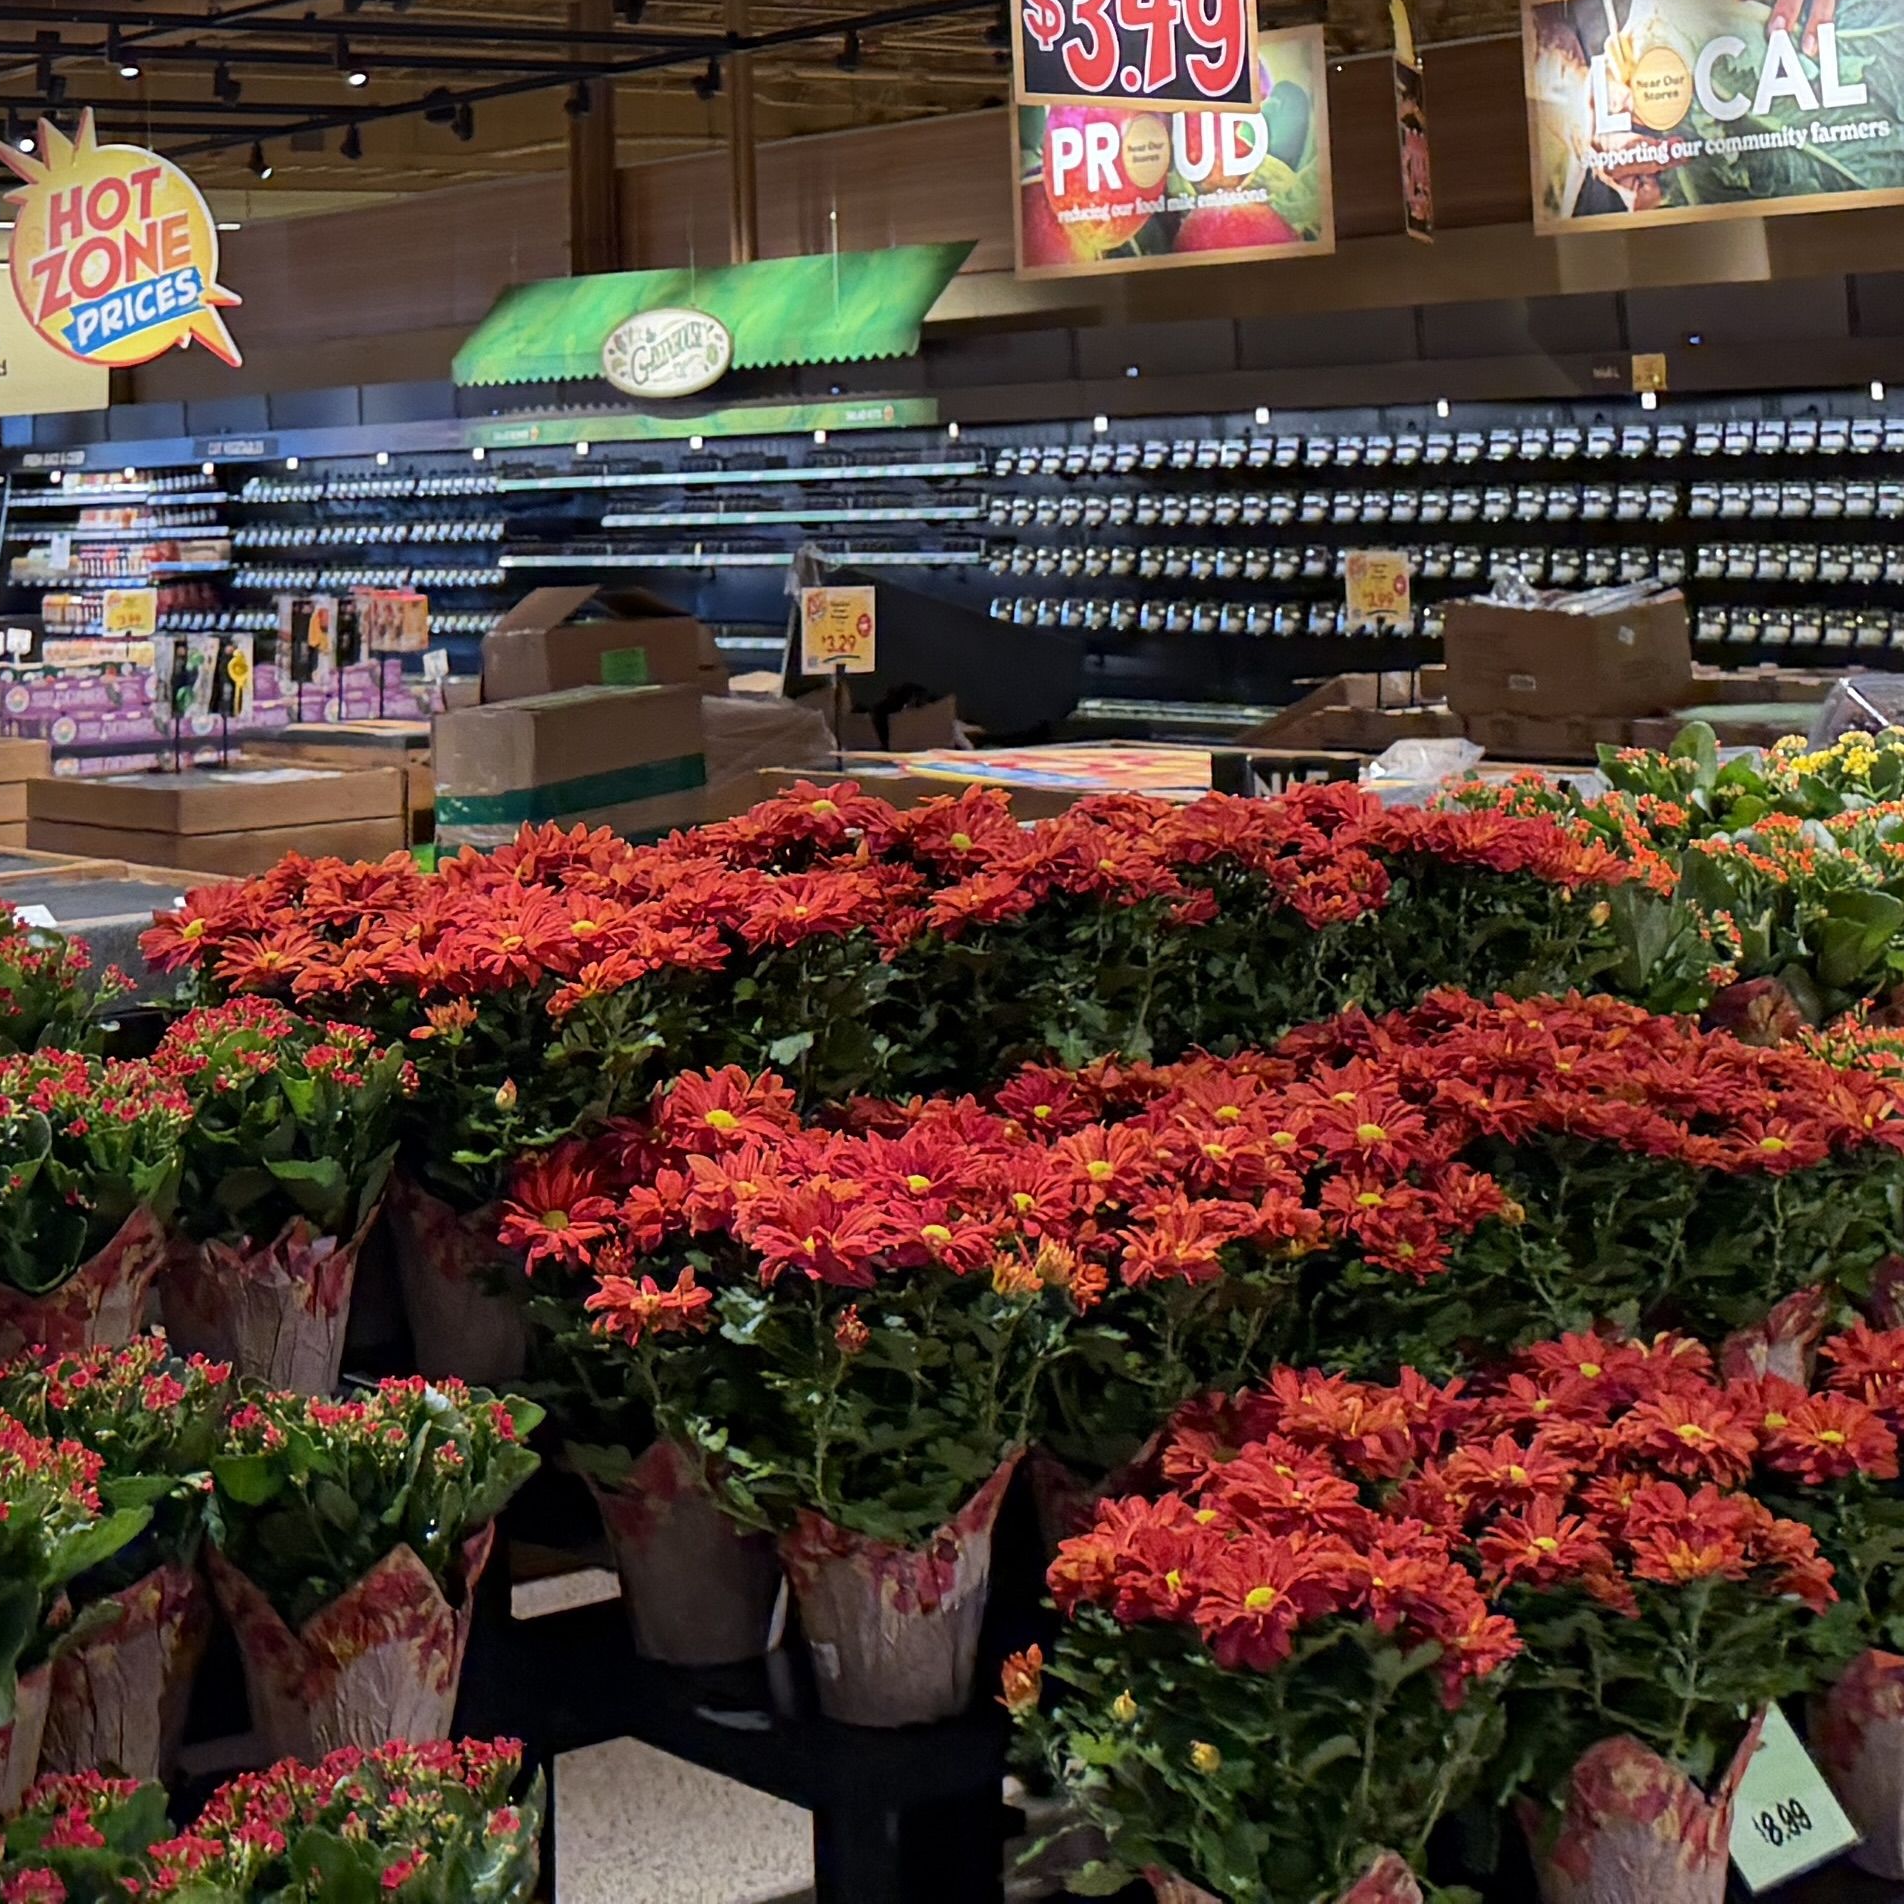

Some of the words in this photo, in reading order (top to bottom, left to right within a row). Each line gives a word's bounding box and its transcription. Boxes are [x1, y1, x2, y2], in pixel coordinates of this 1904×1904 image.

[1663, 74, 1685, 88] Our
[1671, 136, 1704, 158] our
[1705, 125, 1809, 156] community
[1810, 118, 1891, 144] farmers
[48, 166, 161, 248] HOT
[1136, 196, 1166, 215] food
[29, 213, 190, 321] ZONE
[76, 271, 201, 354] PRICES
